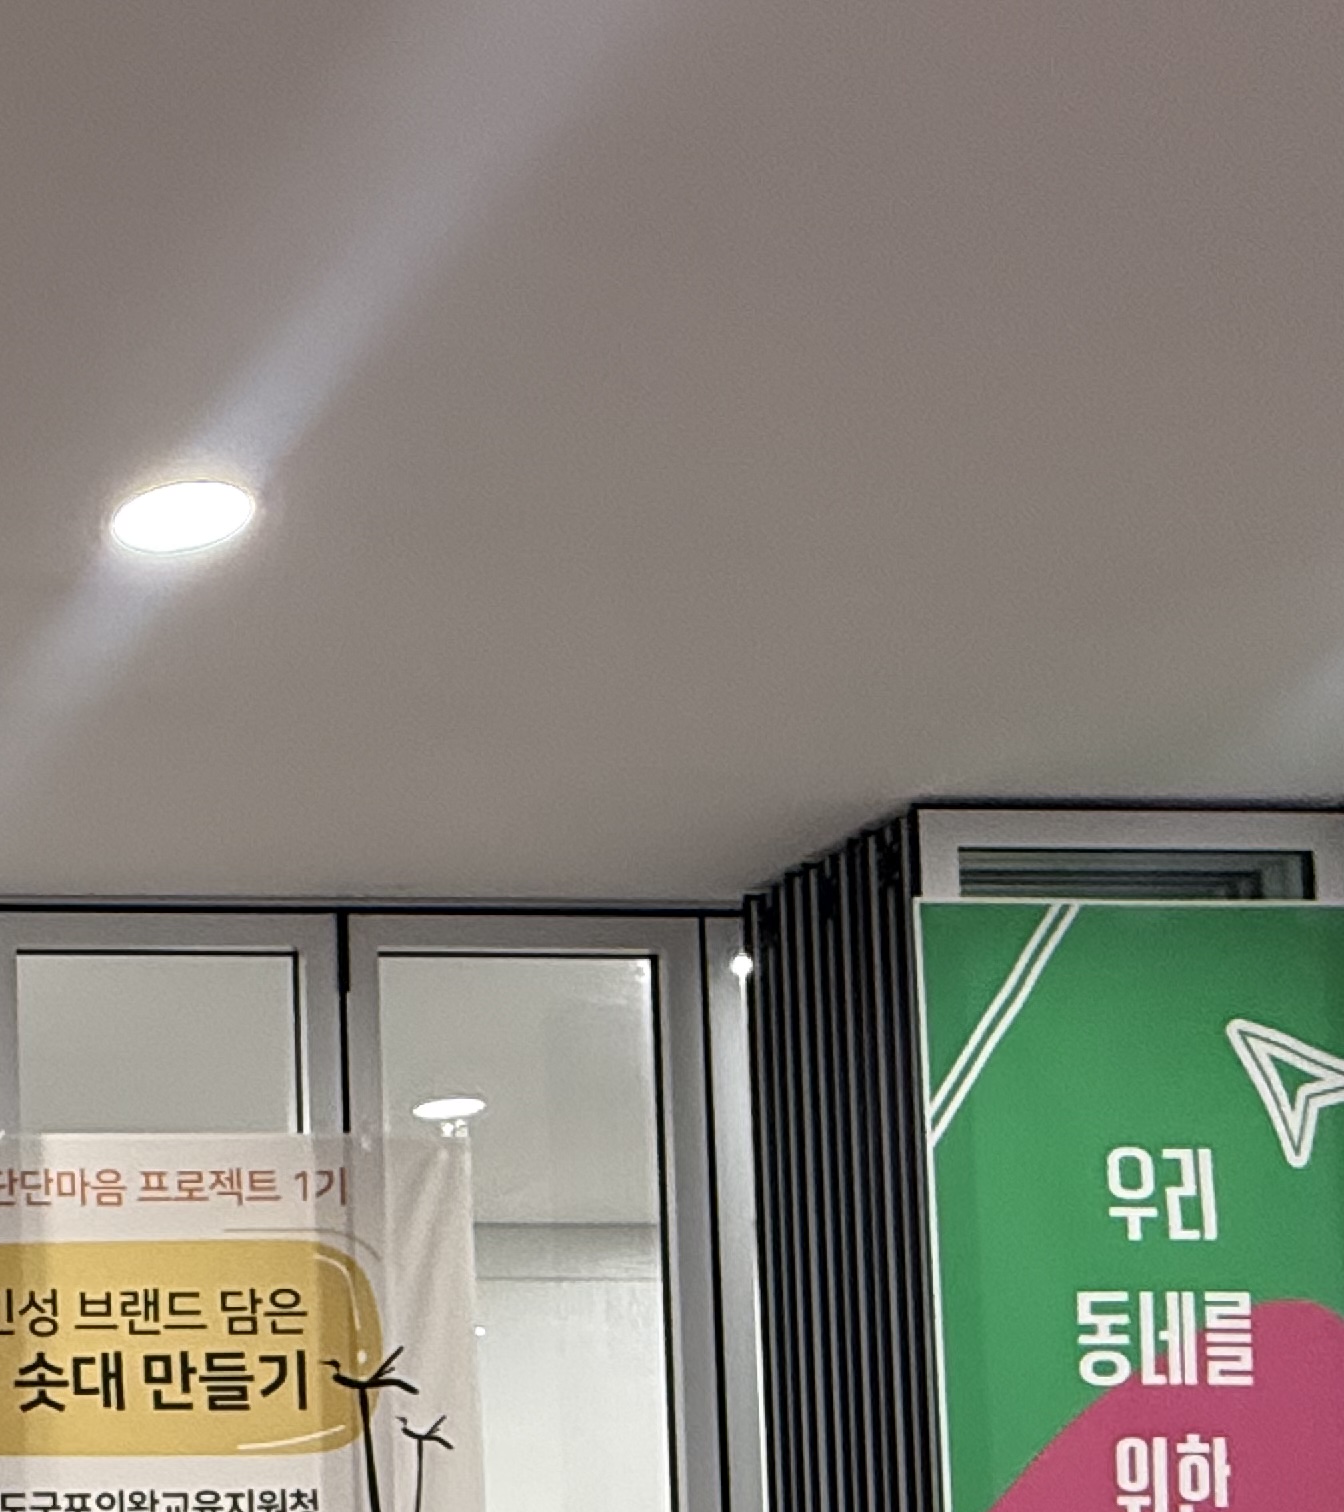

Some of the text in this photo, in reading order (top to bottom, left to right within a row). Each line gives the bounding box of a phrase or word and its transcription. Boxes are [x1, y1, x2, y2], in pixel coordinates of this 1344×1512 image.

[137, 1169, 282, 1206] 프로젝트
[294, 1167, 348, 1206] 1기
[1107, 1147, 1218, 1241] 우리
[74, 1289, 210, 1336] 브랜드
[219, 1288, 309, 1335] 담은
[1076, 1291, 1254, 1386] 동네를
[14, 1350, 126, 1413] 솟대
[143, 1350, 309, 1412] 만들기
